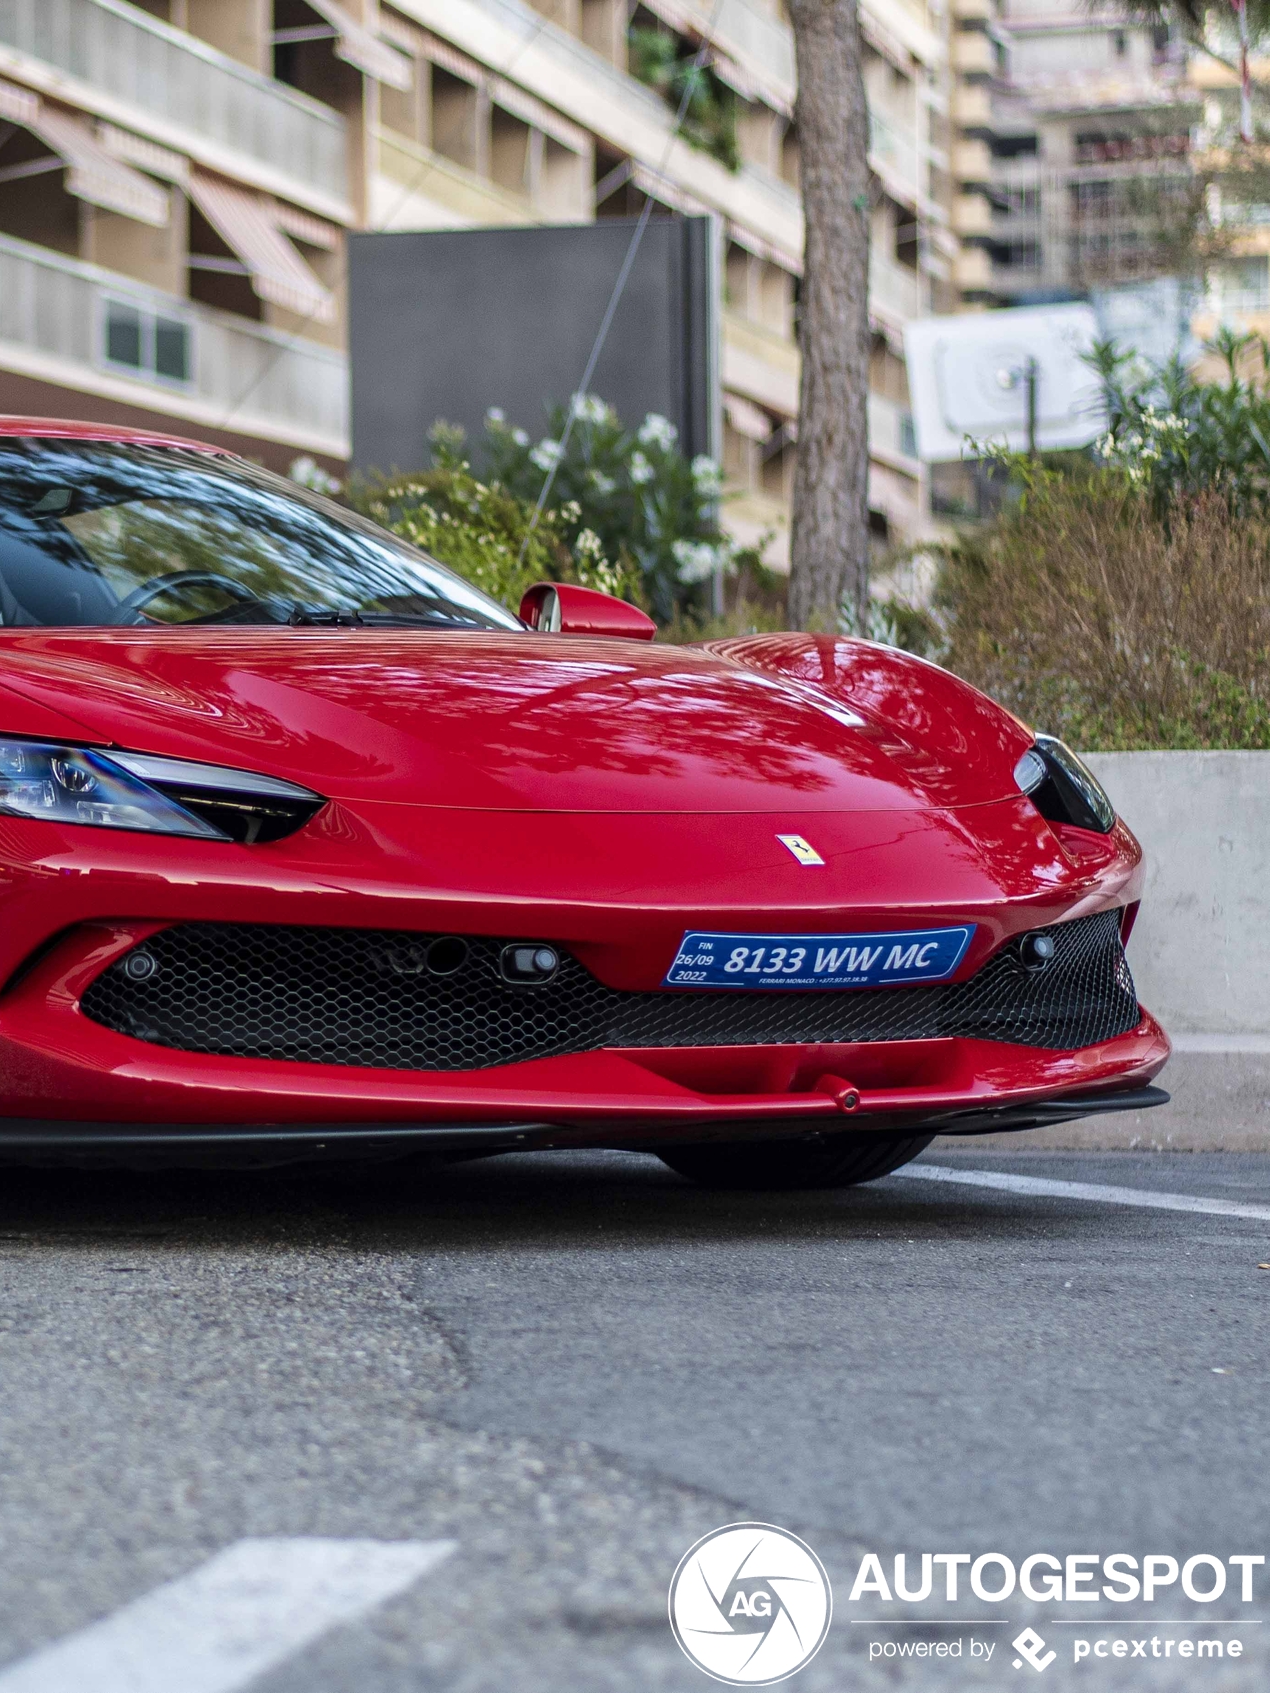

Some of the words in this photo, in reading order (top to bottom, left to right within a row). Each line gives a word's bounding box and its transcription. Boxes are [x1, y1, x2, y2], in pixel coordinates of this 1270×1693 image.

[698, 942, 714, 950] FIN
[676, 954, 714, 966] 26/09
[723, 947, 806, 973] 8133
[813, 945, 883, 973] WW
[882, 942, 939, 970] MC
[675, 971, 707, 981] 2022
